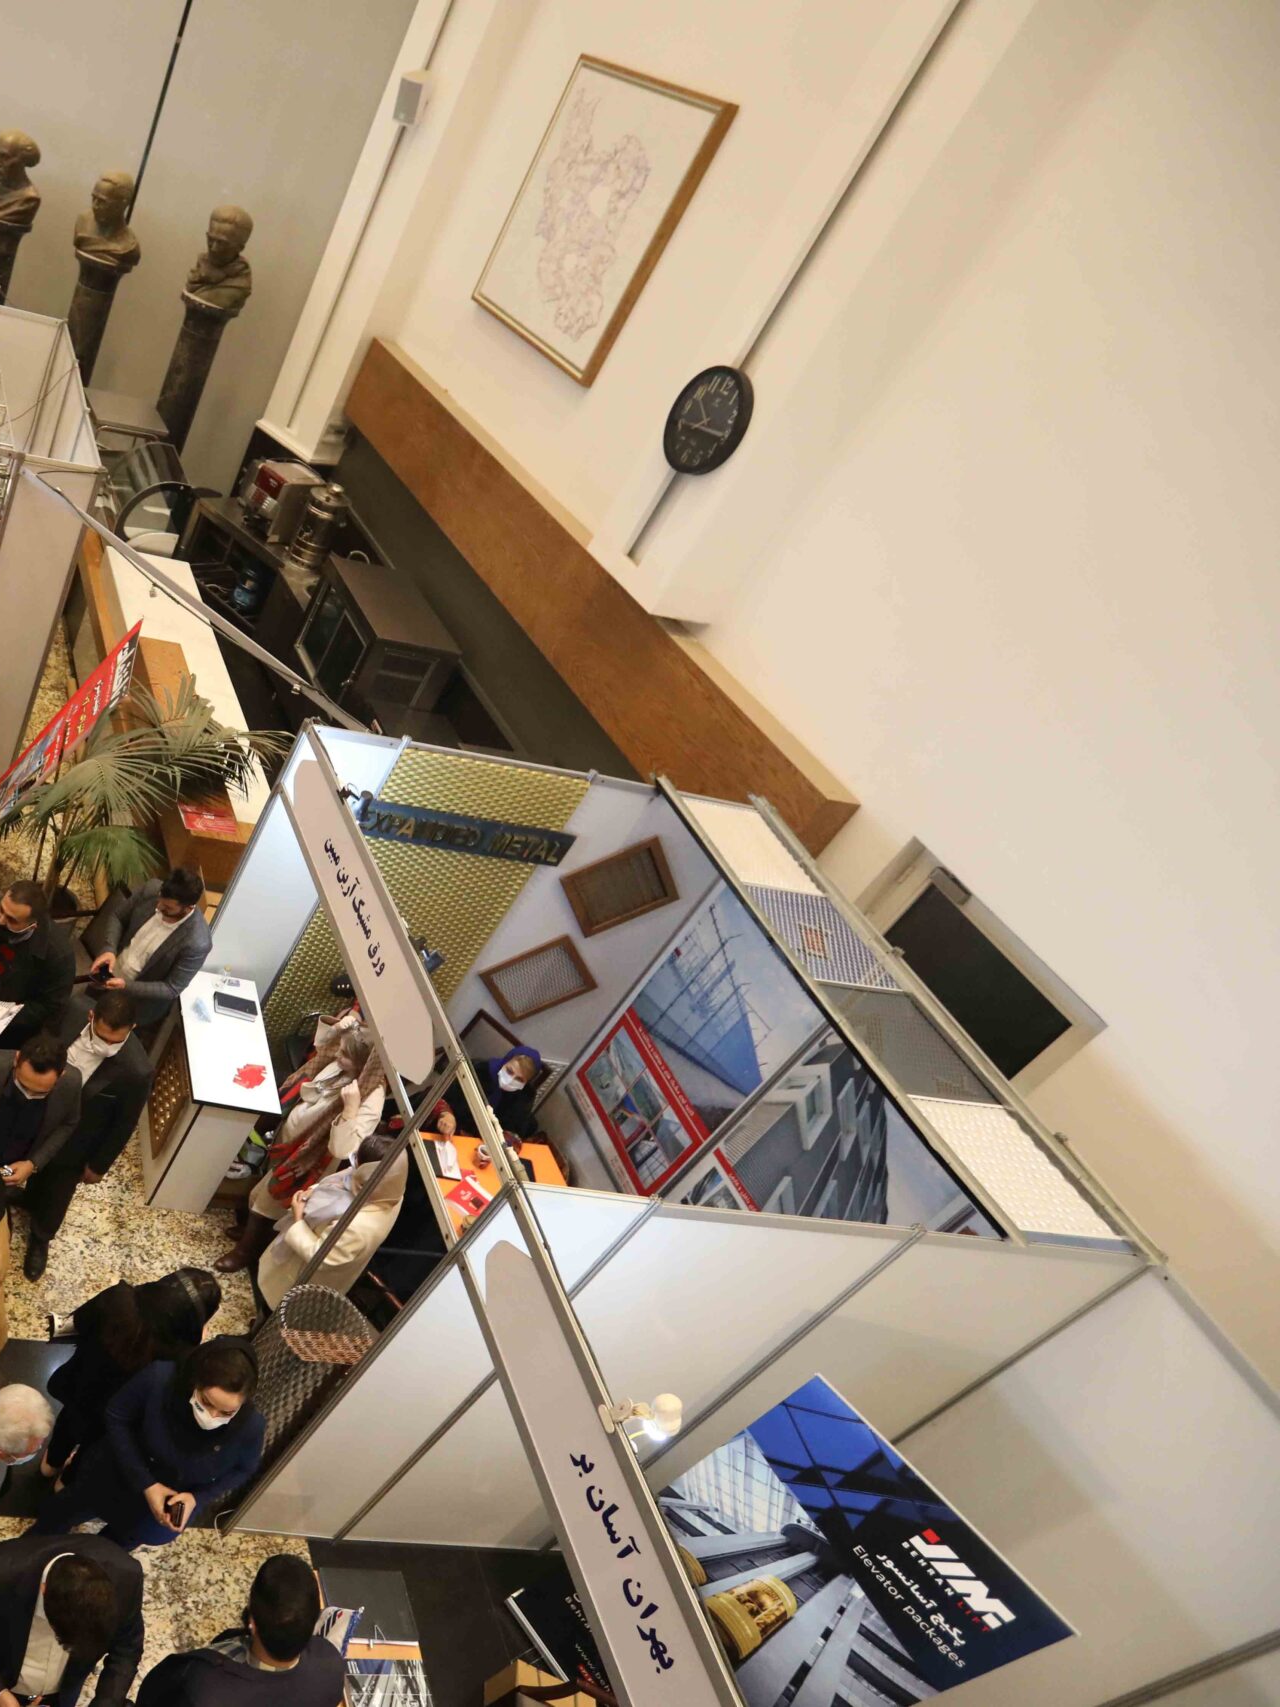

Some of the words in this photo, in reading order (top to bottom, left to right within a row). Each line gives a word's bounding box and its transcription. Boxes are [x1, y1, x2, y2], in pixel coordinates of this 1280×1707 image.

[488, 831, 563, 864] METAL
[352, 896, 372, 940] مشبک
[368, 942, 386, 978] ورق
[570, 1453, 595, 1478] بر
[586, 1485, 641, 1559] آسان
[853, 1545, 905, 1600] Elevator
[902, 1605, 966, 1668] packages
[876, 1554, 938, 1610] آسانسور
[901, 1541, 955, 1596] BEHRAN
[957, 1601, 990, 1632] LIFT
[623, 1578, 674, 1674] بهران
[930, 1612, 966, 1648] پکیج
